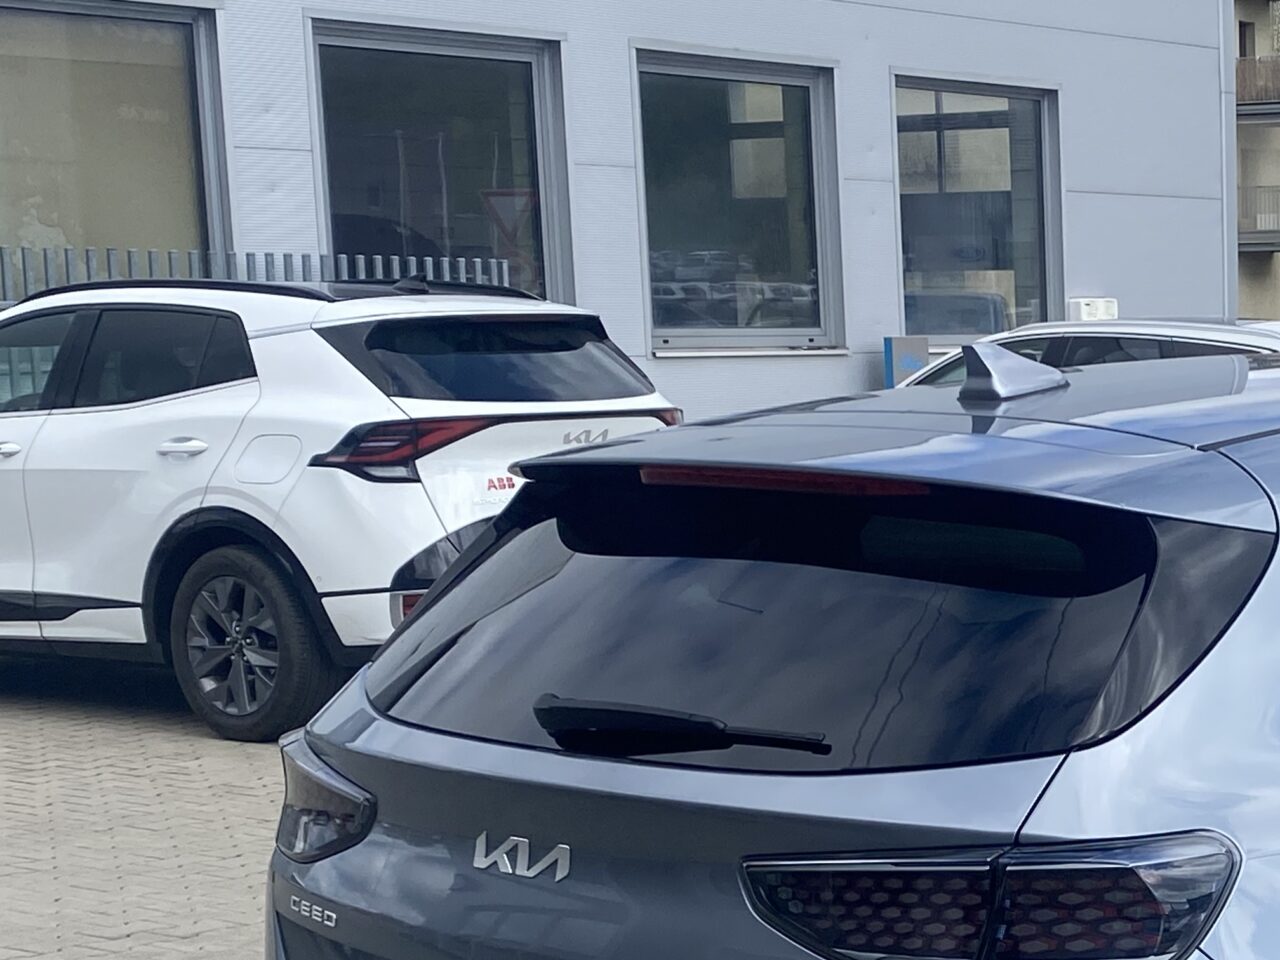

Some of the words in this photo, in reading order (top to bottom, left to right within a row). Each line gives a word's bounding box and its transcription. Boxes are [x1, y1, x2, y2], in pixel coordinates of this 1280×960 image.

[487, 476, 515, 491] ABB
[473, 830, 571, 883] KIA
[290, 895, 337, 928] CEED
